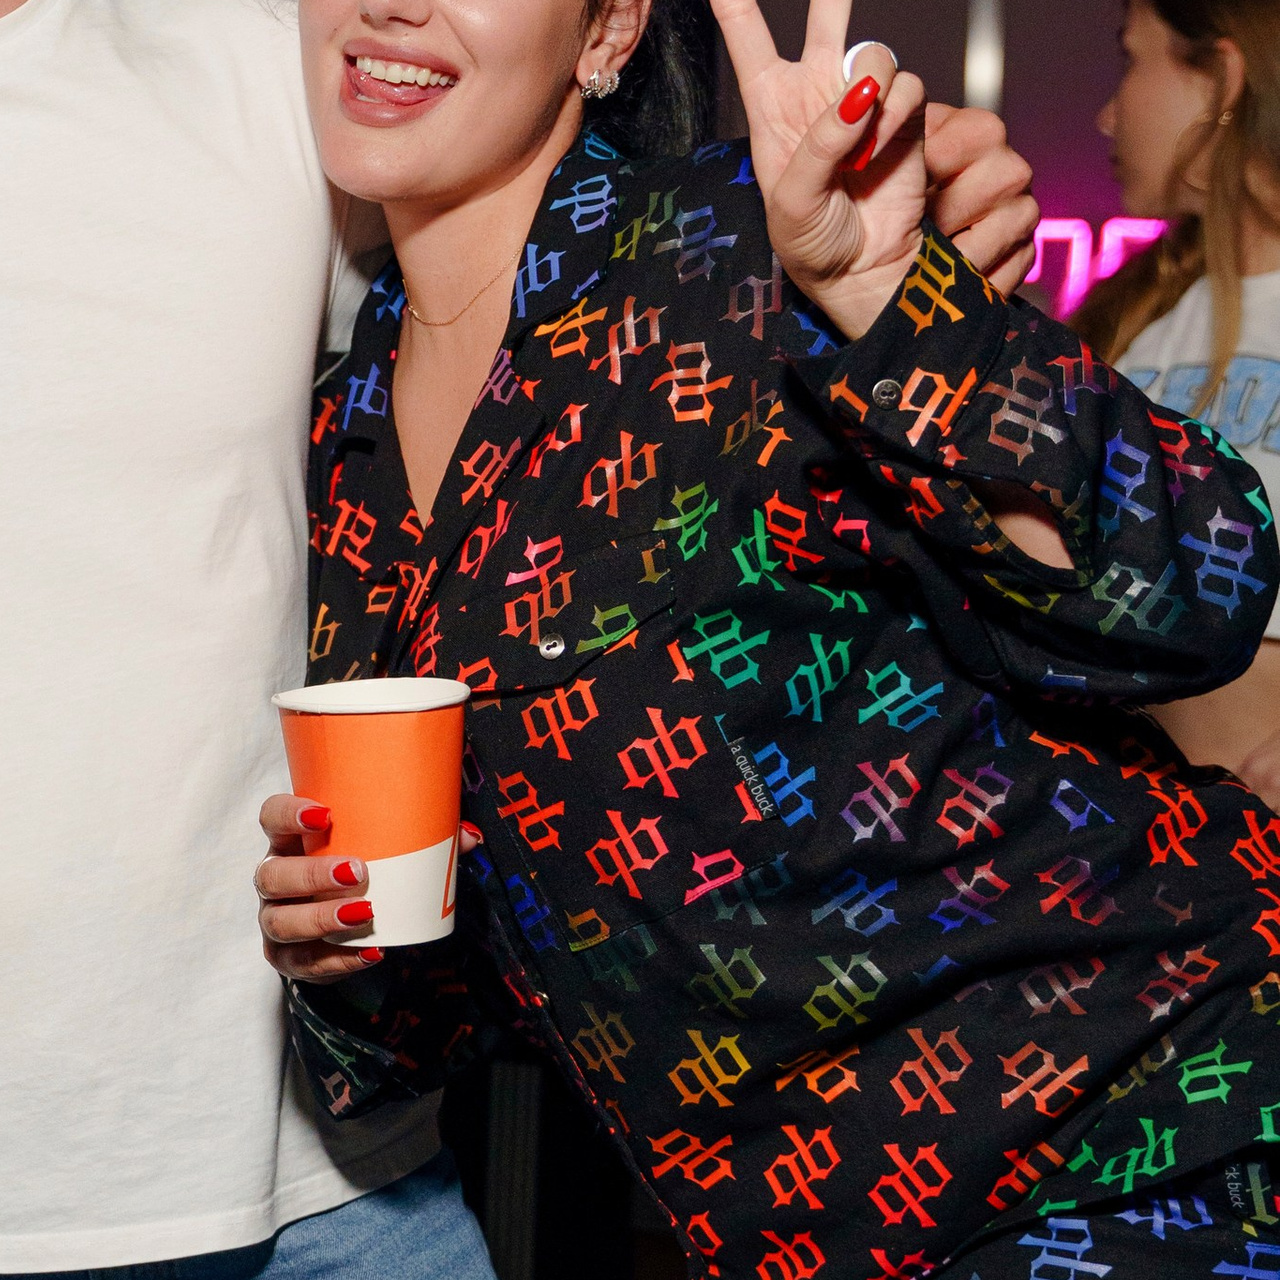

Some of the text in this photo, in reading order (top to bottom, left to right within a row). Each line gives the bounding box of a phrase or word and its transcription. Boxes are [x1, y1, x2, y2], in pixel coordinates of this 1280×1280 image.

[730, 745, 774, 816] a quick buck
[1227, 1182, 1245, 1209] buck
